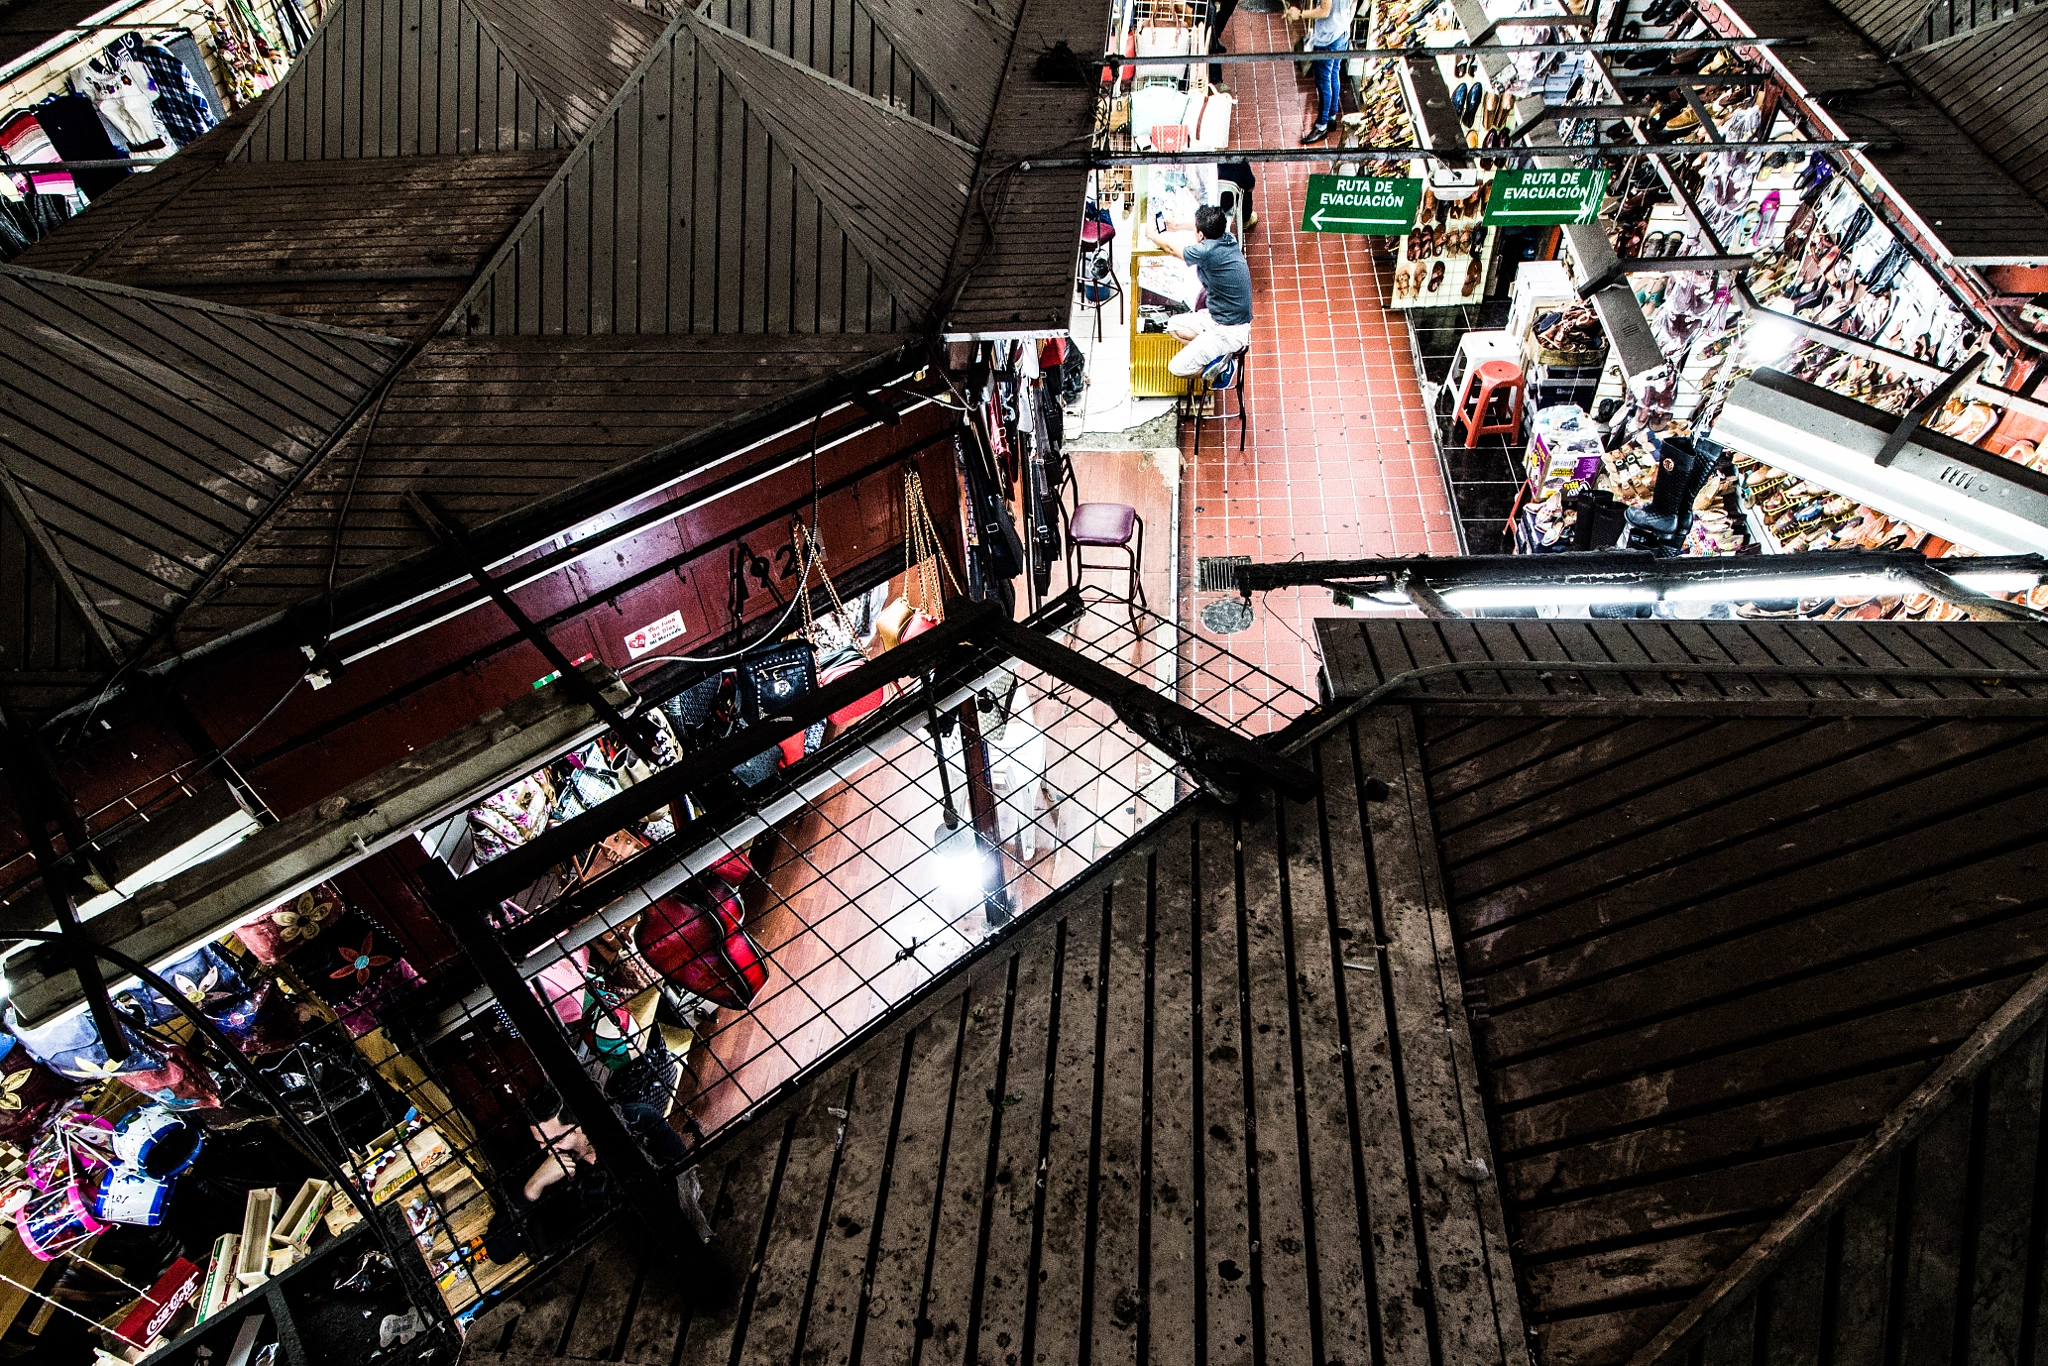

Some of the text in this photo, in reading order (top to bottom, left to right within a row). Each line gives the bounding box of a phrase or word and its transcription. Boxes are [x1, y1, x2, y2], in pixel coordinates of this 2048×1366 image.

[1522, 172, 1580, 185] RUTA DE
[1336, 179, 1393, 193] RUTA DE
[1503, 185, 1588, 199] EVACUACIÓN
[1320, 193, 1404, 207] EVACUACIÓN
